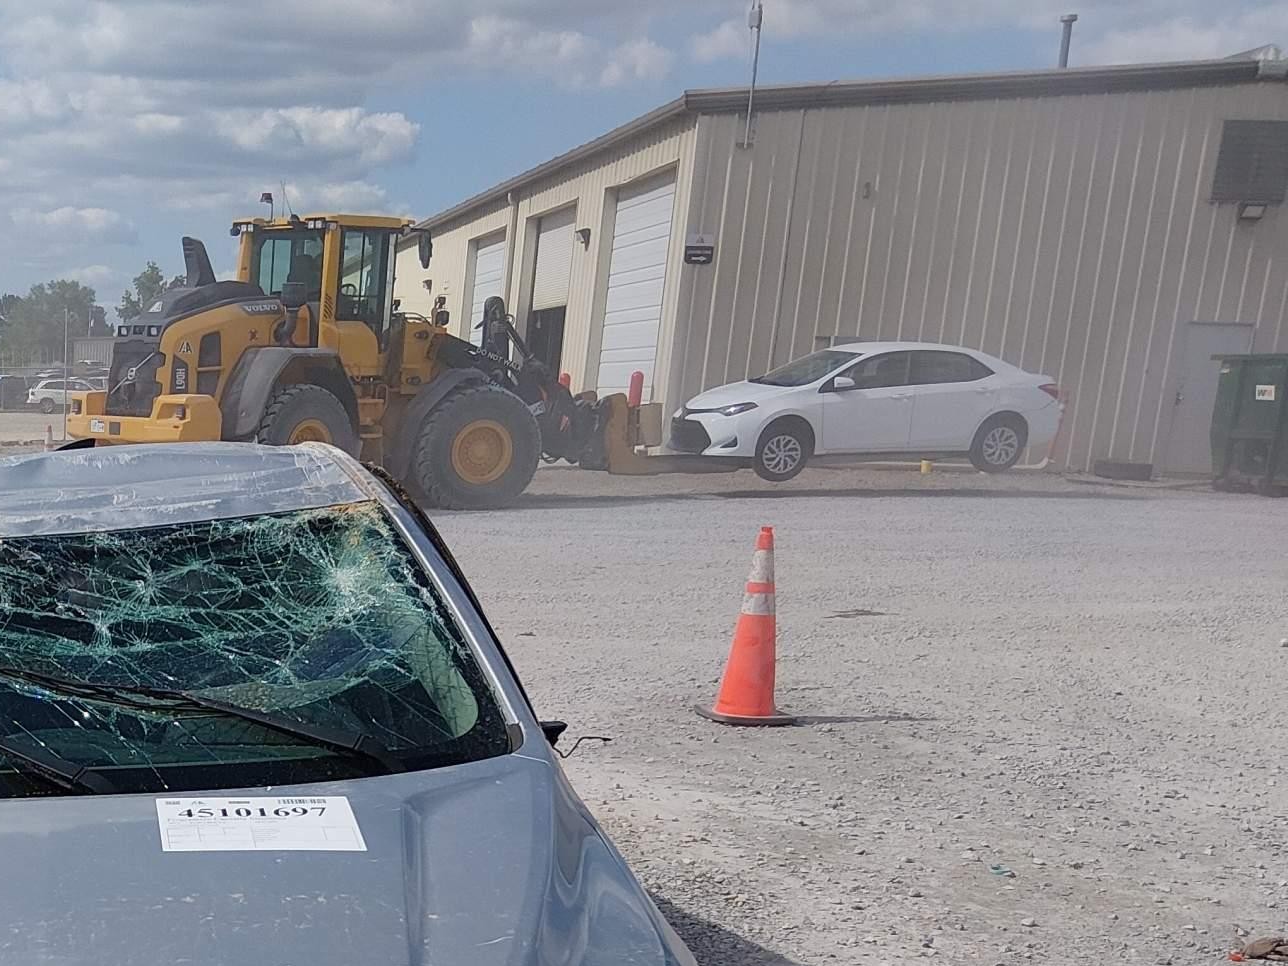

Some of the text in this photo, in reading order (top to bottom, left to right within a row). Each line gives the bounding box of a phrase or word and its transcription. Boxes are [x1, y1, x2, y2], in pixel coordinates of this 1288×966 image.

[245, 304, 278, 312] VOLVO
[476, 348, 487, 356] DO
[488, 352, 503, 363] NOT
[175, 368, 186, 390] L90H
[178, 807, 327, 818] 45101697
